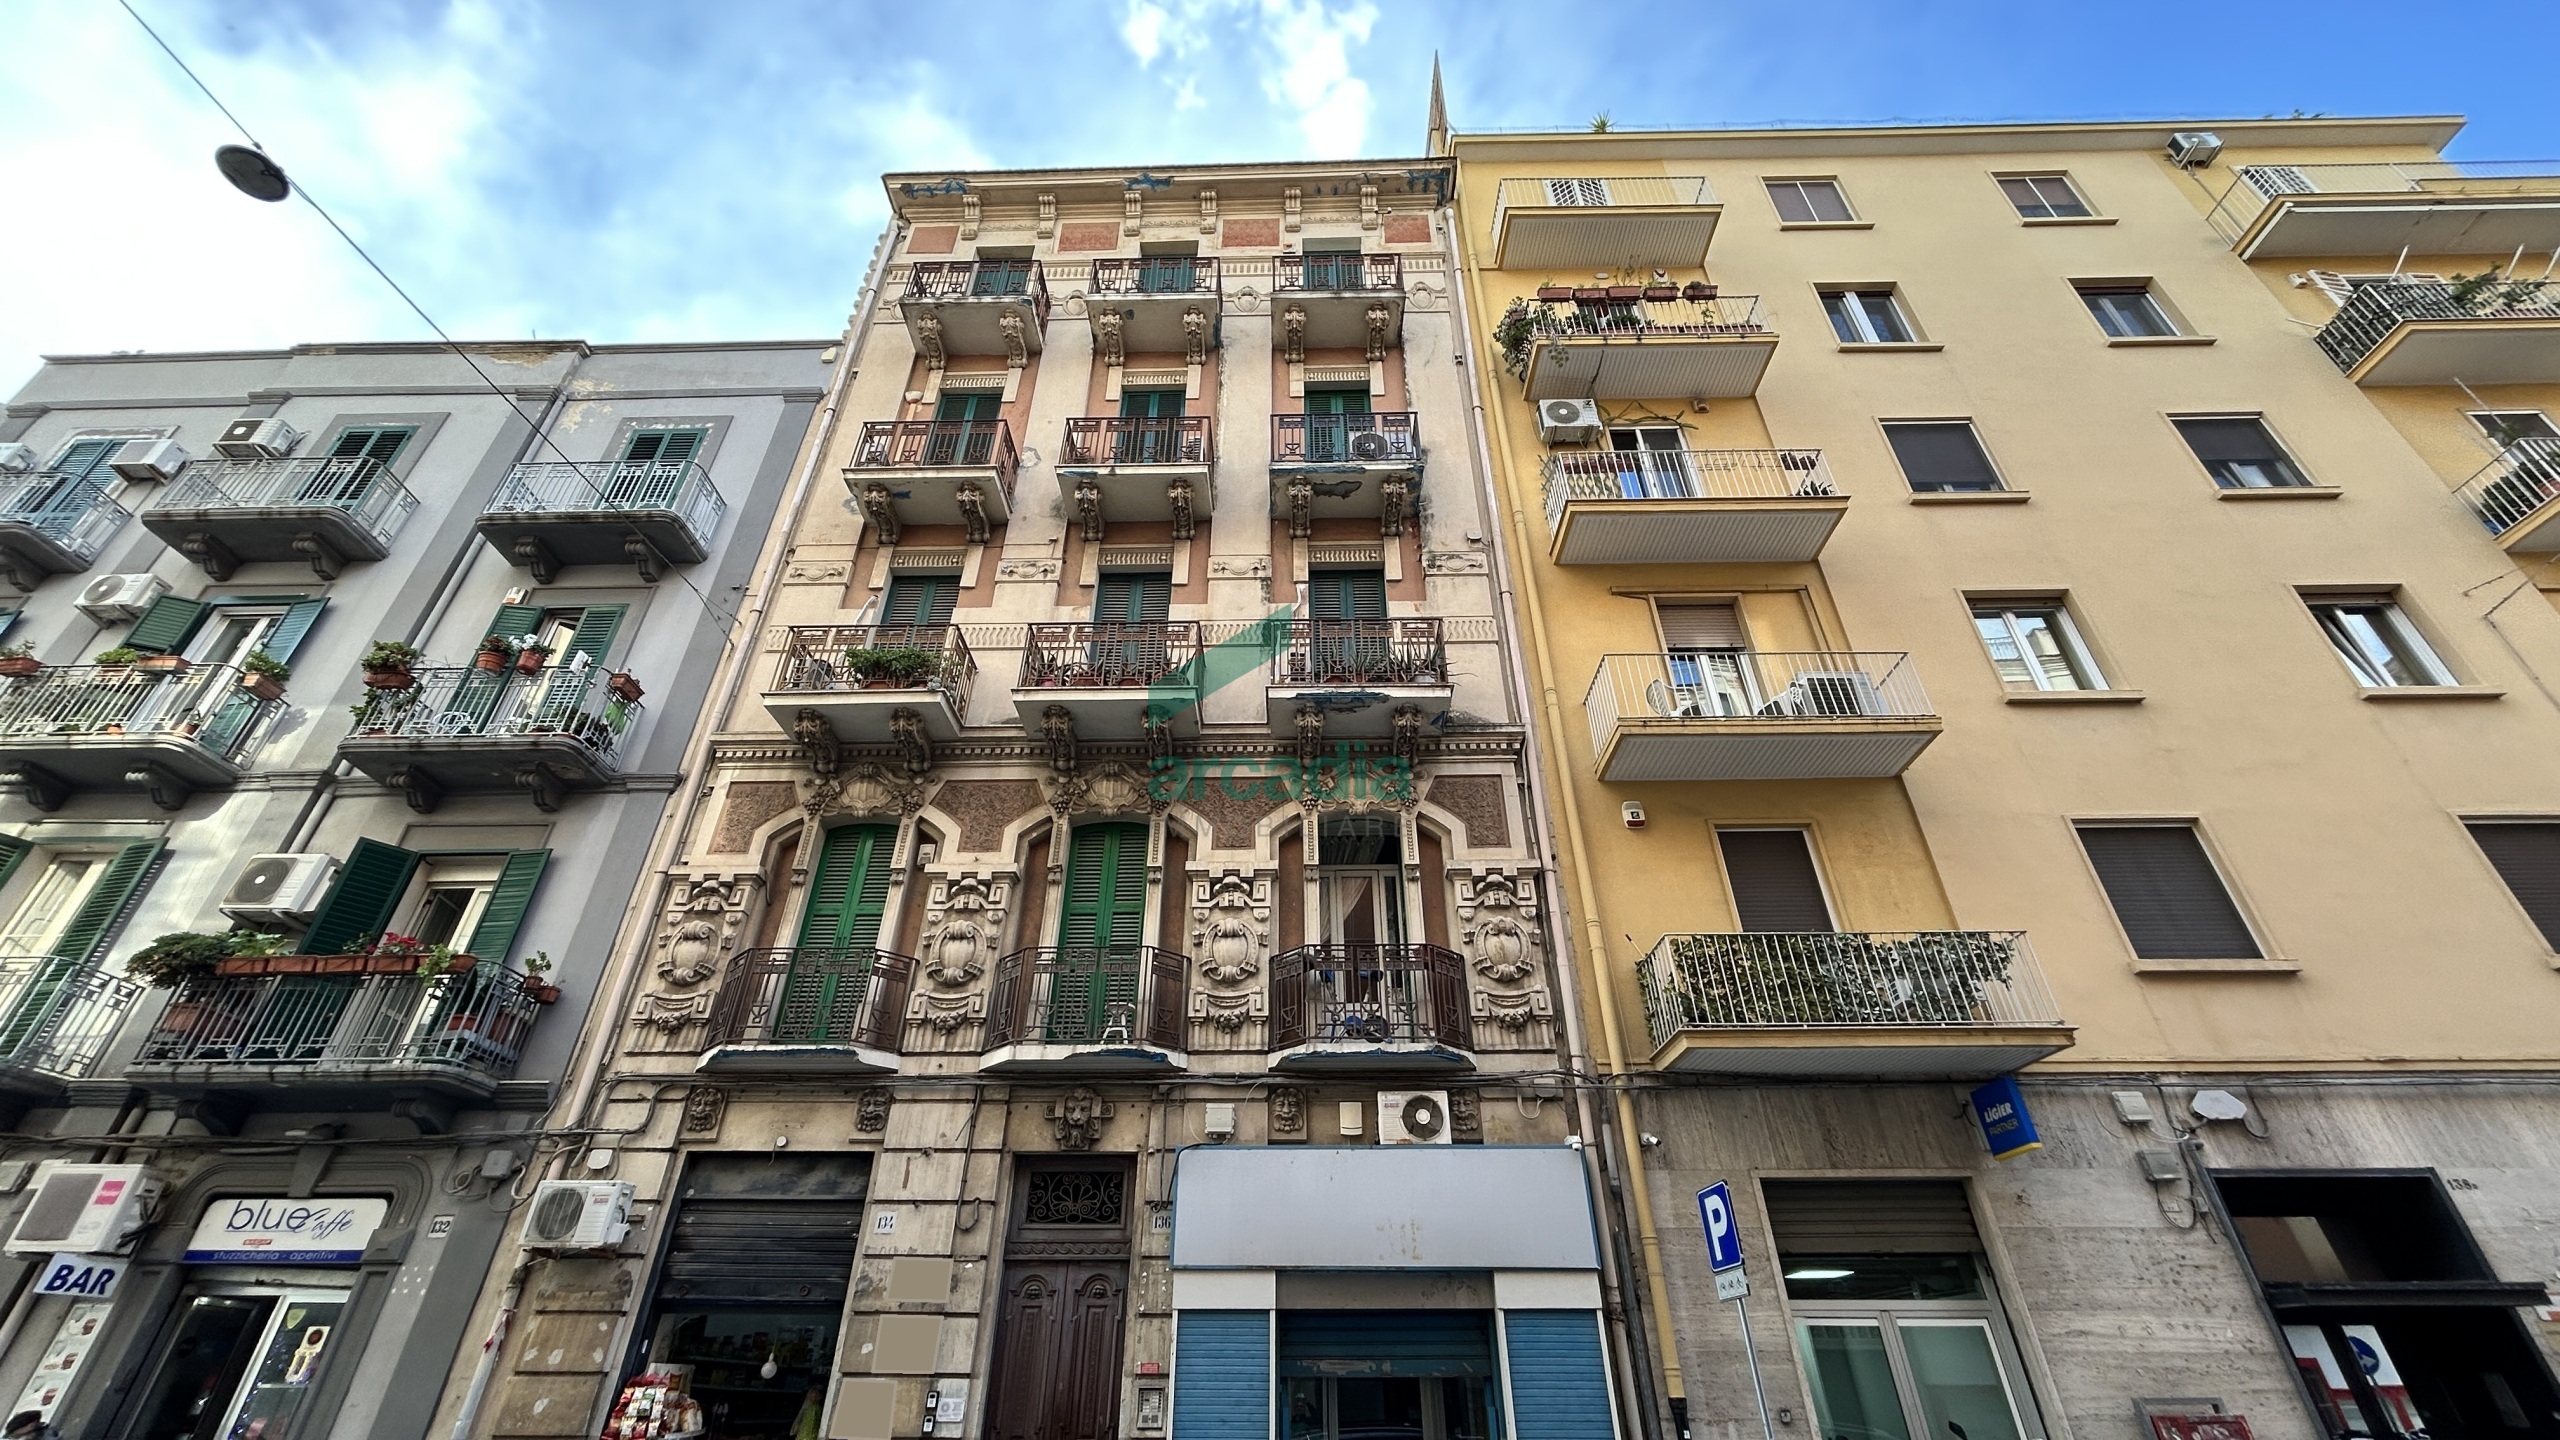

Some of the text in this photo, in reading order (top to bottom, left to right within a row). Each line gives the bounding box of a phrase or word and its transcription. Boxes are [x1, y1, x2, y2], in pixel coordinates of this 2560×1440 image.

[1984, 1102, 2013, 1123] LIGIER
[225, 1200, 311, 1230] blue
[877, 1216, 894, 1229] 134
[1154, 1215, 1171, 1229] 136
[430, 1220, 451, 1234] 132
[1704, 1194, 1728, 1262] P
[213, 1250, 280, 1261] stuzzicheria
[288, 1251, 338, 1262] aperitivi
[43, 1264, 116, 1295] BAR
